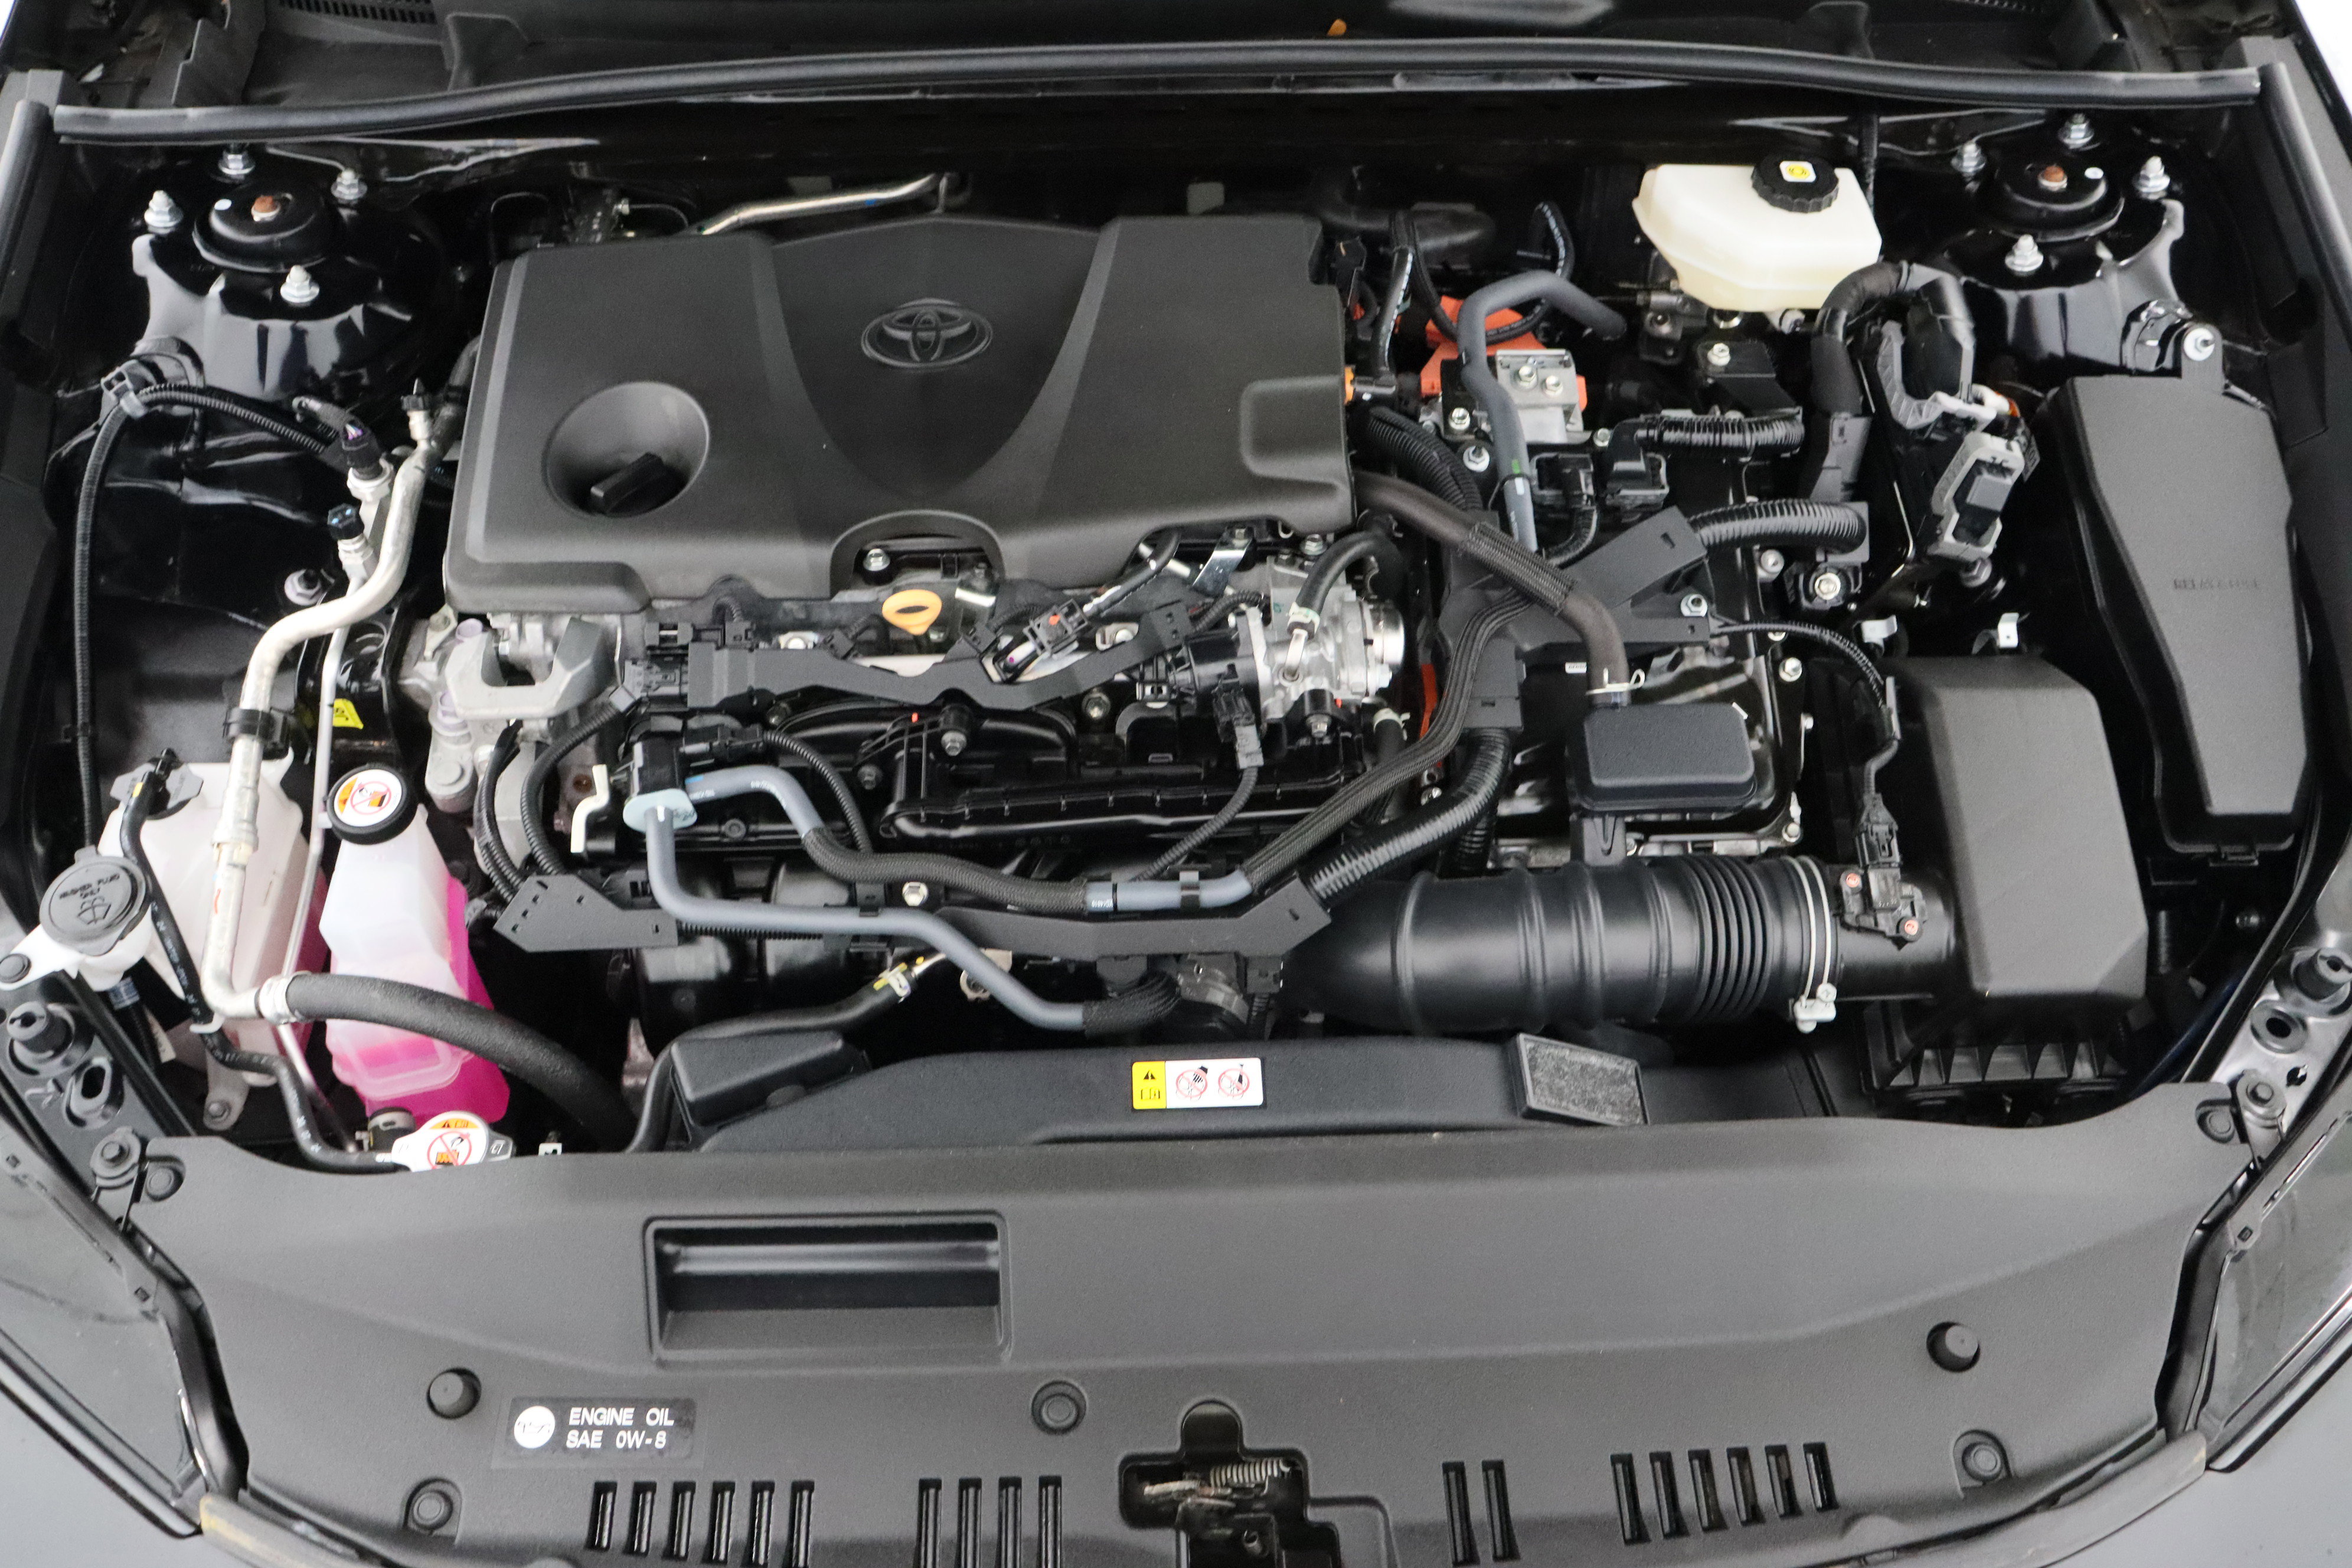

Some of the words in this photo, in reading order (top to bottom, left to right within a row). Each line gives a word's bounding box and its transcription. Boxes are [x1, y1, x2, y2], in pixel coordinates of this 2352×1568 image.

[569, 1407, 635, 1426] ENGINE
[646, 1407, 675, 1426] OIL
[566, 1429, 603, 1449] SAE
[616, 1430, 667, 1449] 0W-8
